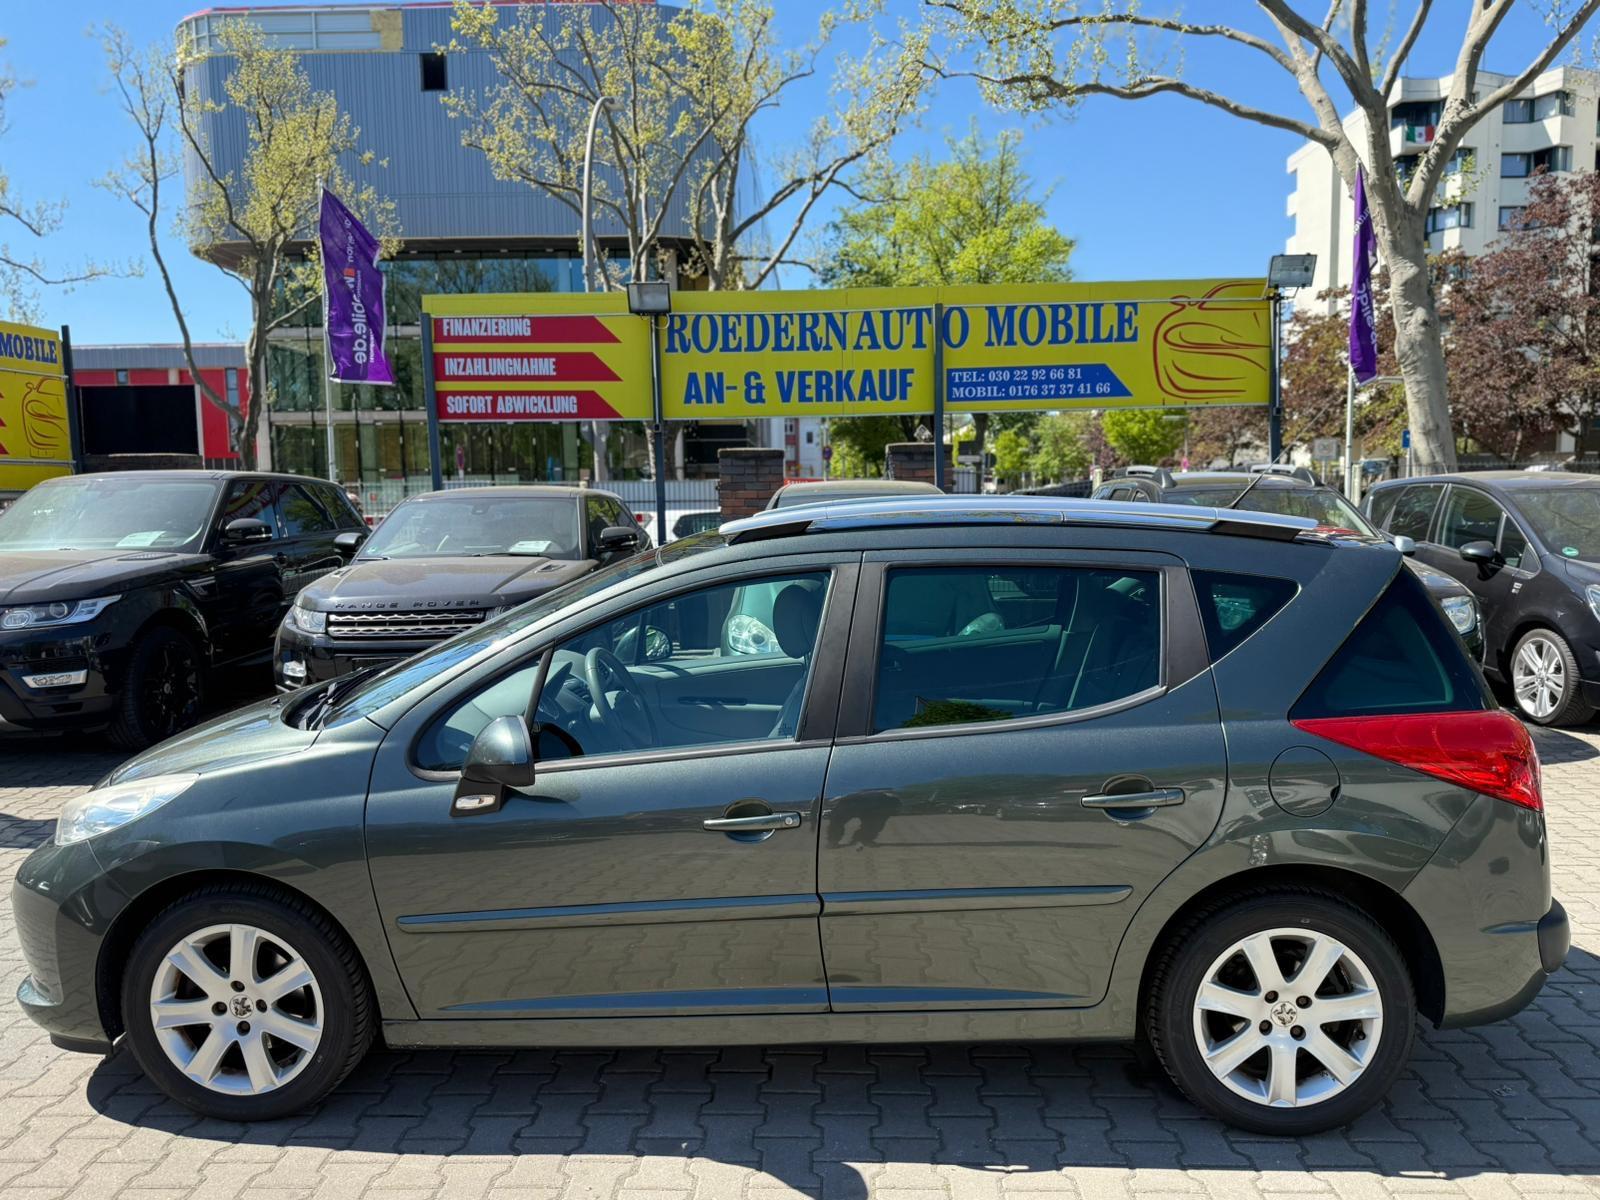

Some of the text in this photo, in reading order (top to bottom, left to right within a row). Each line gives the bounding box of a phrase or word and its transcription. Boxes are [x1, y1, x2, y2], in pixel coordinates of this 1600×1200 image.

[443, 318, 531, 336] FINANZIERUNG
[985, 302, 1138, 346] MOBILE
[444, 358, 556, 376] INZAHLUNGNAHME
[952, 367, 1083, 383] TEL: 030 22 92 66 81
[775, 368, 915, 403] VERKAUF
[952, 382, 1111, 398] MOBIL: 0176 37 37 41 66
[446, 395, 578, 414] SOFORT ABWICKLUNG
